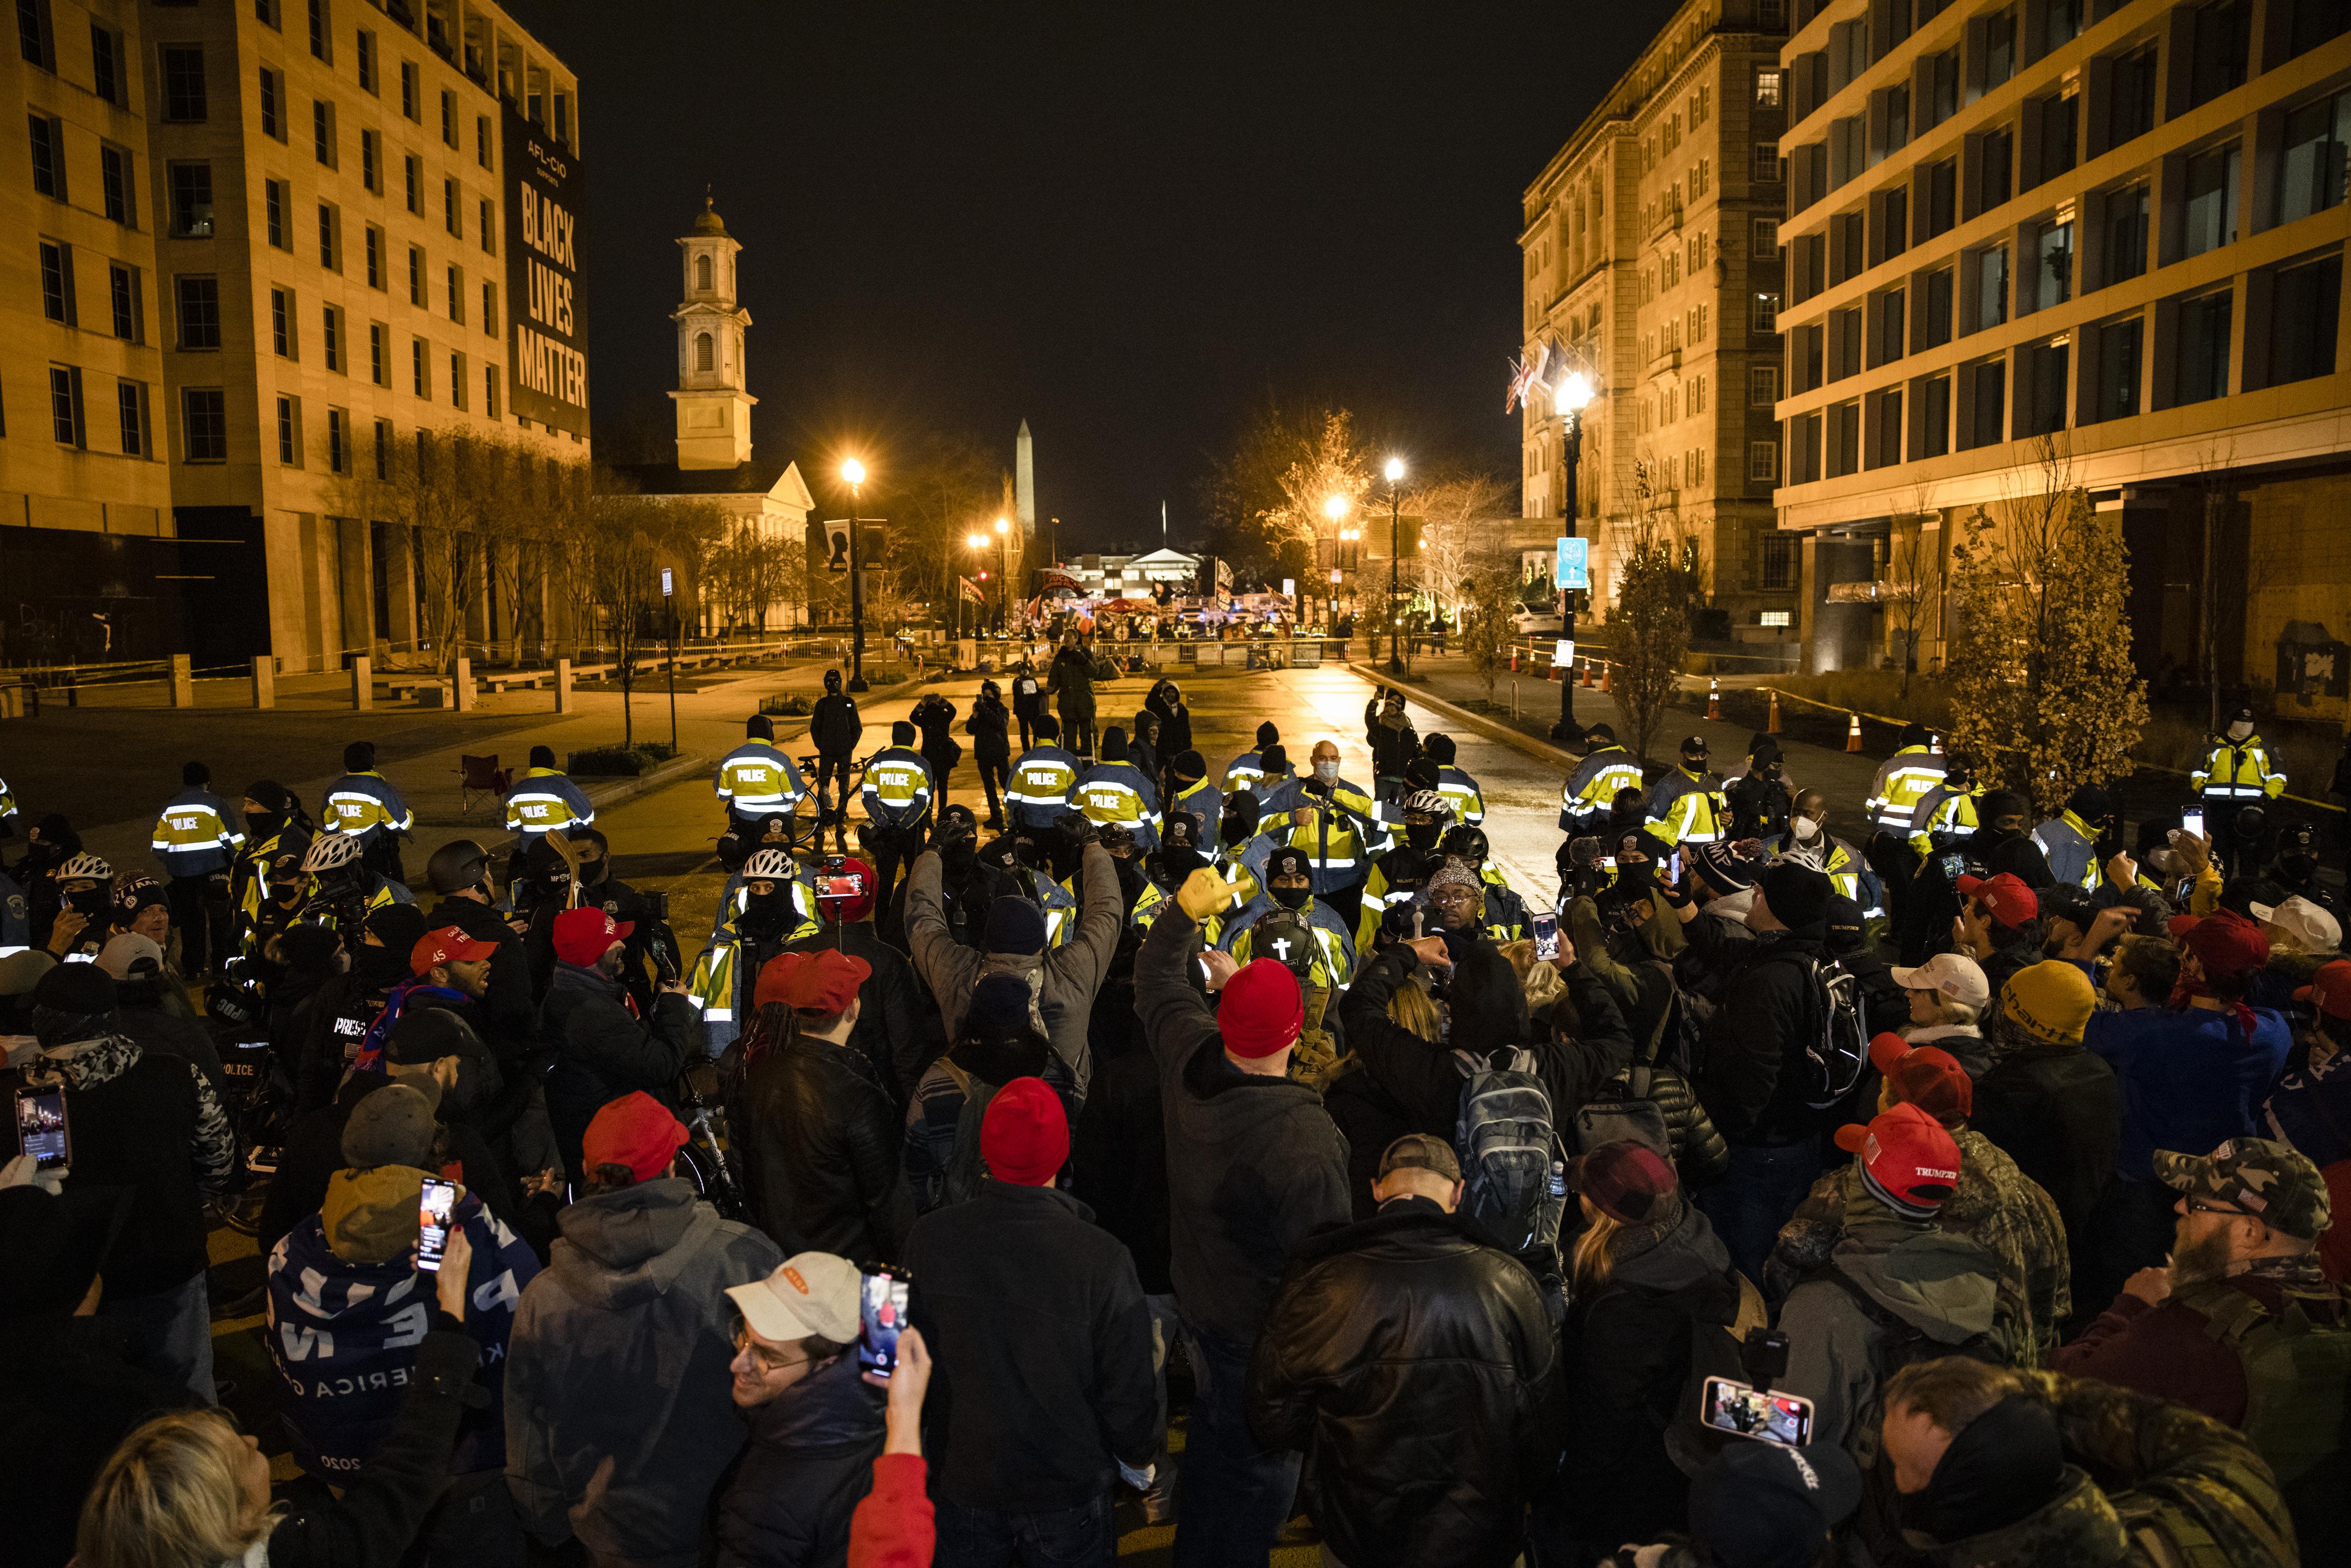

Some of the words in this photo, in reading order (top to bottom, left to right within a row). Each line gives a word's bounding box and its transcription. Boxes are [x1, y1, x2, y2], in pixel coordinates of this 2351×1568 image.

[528, 140, 566, 179] AFL-CIO
[537, 167, 558, 188] SUPPORTS
[521, 180, 576, 273] BLACK
[528, 257, 573, 338] LIVES
[517, 324, 586, 409] MATTER
[737, 769, 767, 782] POLICE
[879, 773, 910, 786] POLICE
[1027, 772, 1057, 785] POLICE
[1089, 794, 1120, 809] POLICE
[519, 805, 549, 818] POLICE
[127, 897, 135, 907] 45
[456, 933, 471, 943] TRU
[433, 949, 446, 962] 45
[222, 1062, 254, 1076] OLICE
[1915, 1167, 1957, 1180] TRUMP2020
